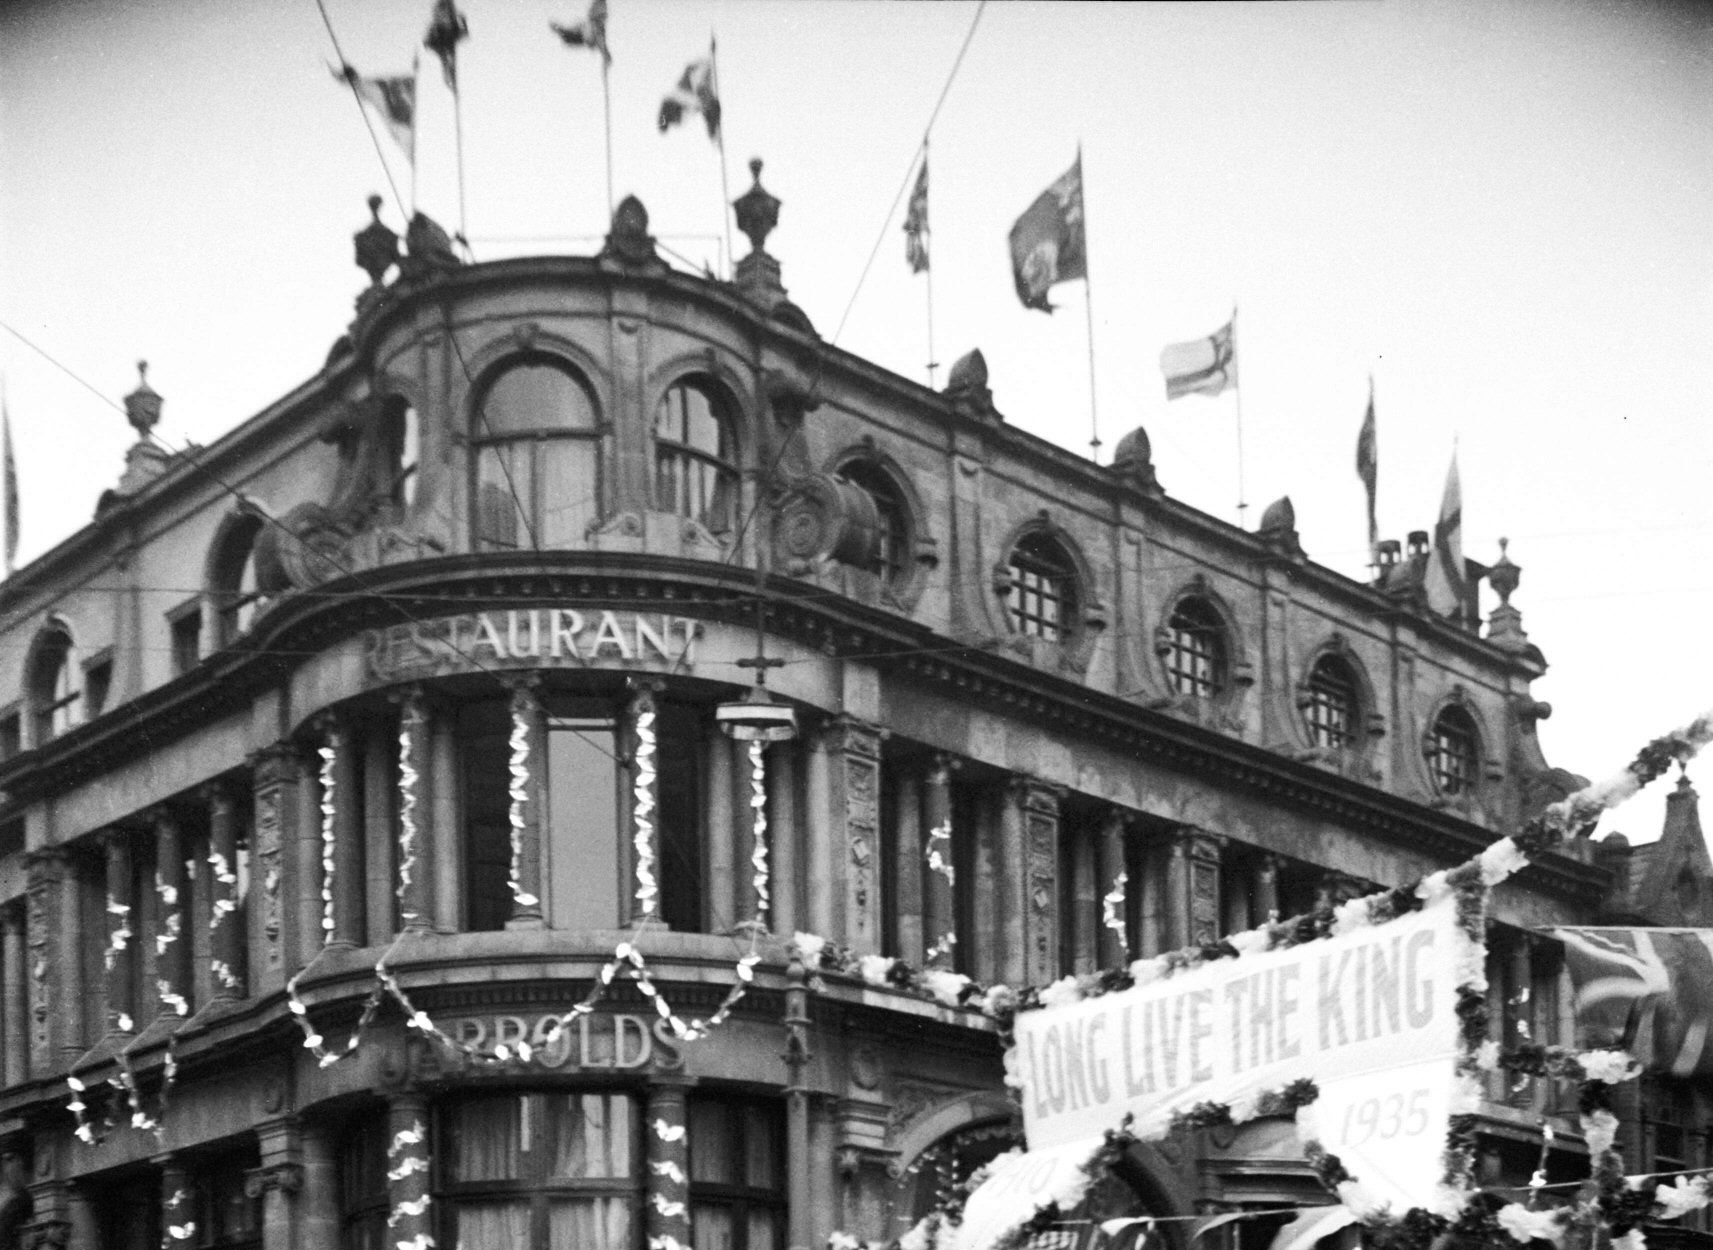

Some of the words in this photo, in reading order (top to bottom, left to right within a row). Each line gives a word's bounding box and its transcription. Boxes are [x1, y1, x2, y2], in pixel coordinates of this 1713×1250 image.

[1027, 1012, 1110, 1120] LONG
[1121, 989, 1214, 1098] LIVE
[1224, 962, 1301, 1075] THE
[1317, 929, 1435, 1051] KING
[1341, 1088, 1431, 1145] 1935
